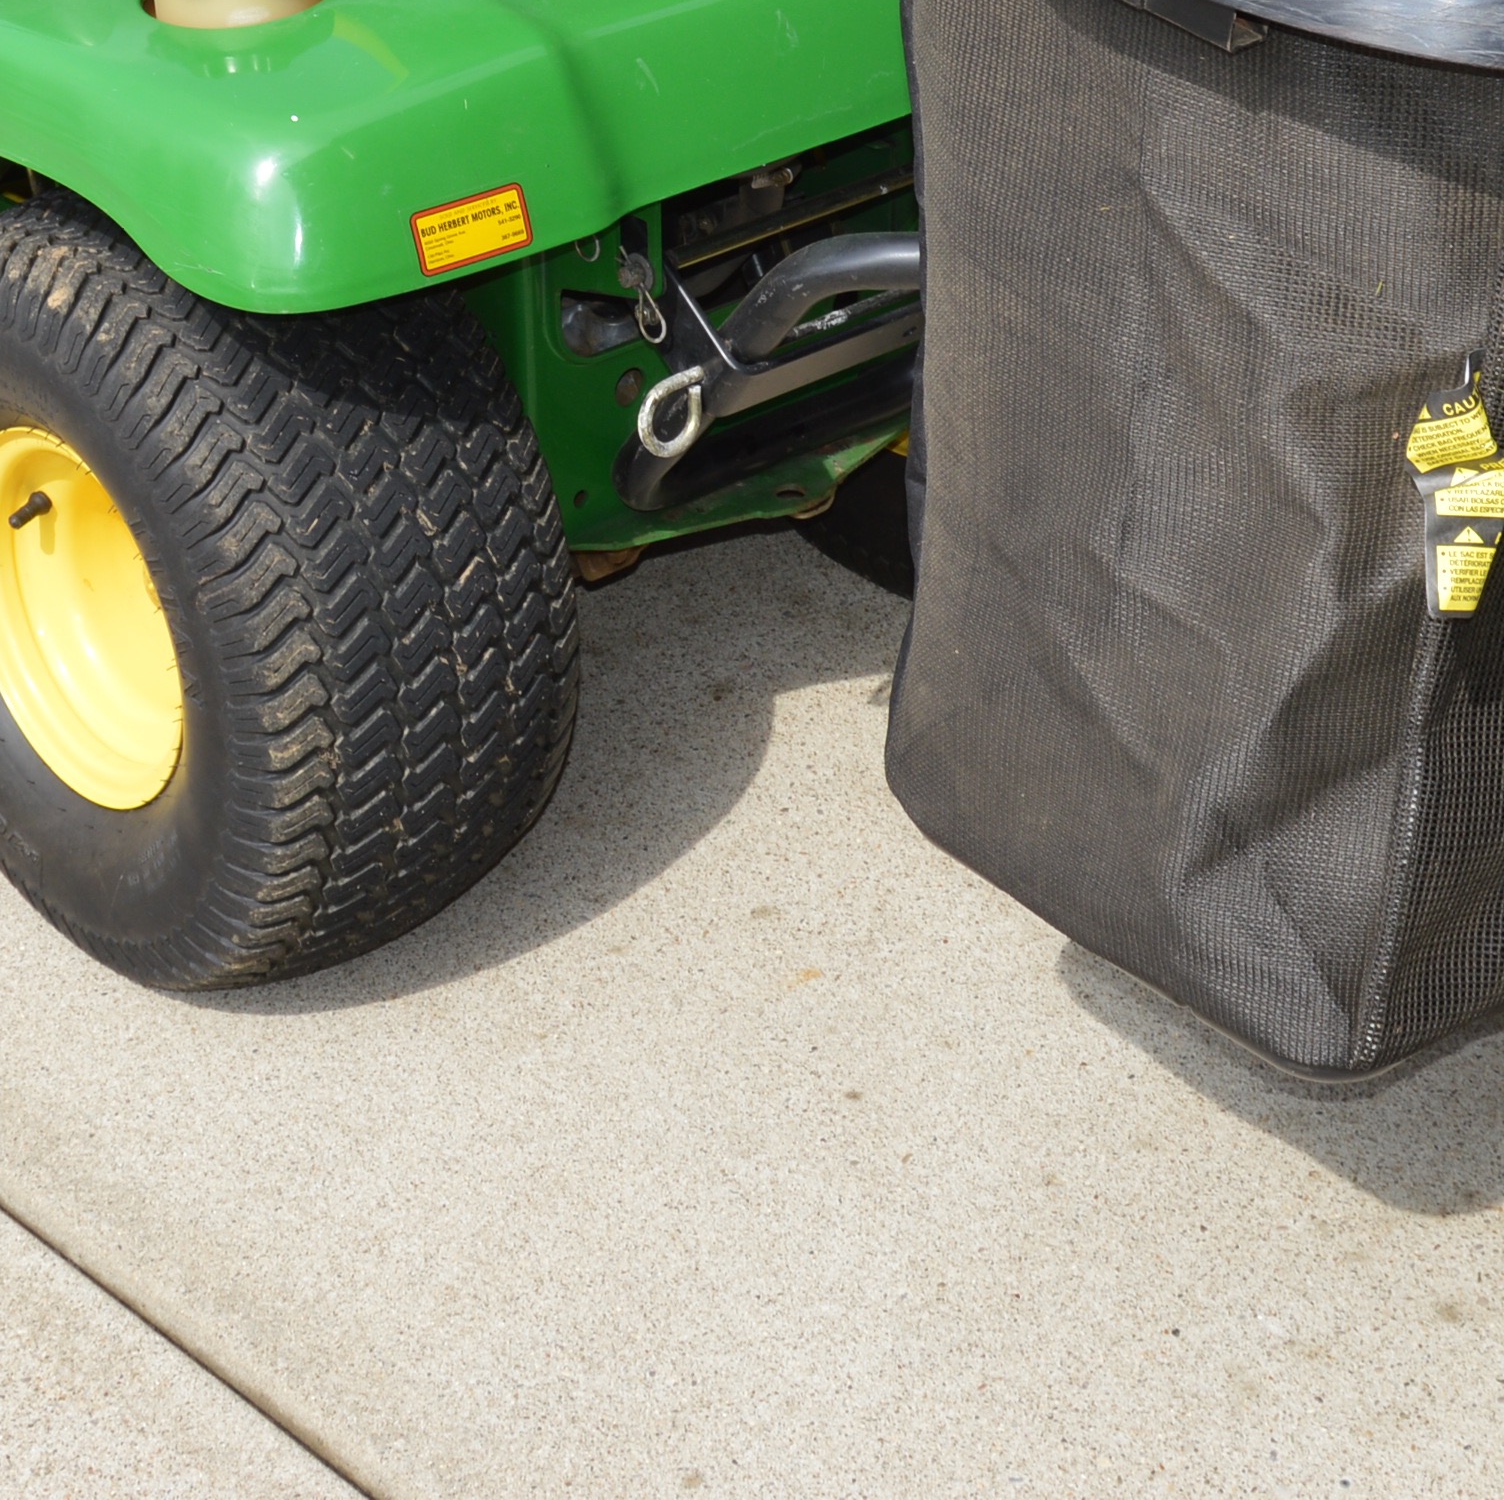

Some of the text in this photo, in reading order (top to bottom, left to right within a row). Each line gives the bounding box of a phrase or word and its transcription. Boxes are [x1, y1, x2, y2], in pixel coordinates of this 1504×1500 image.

[420, 199, 519, 238] BUD HERBERT MOTORS, INC.
[1471, 497, 1499, 505] BOLSAS
[1460, 551, 1475, 559] SAC
[1450, 586, 1476, 594] UTILISER
[1450, 594, 1461, 602] AUX
